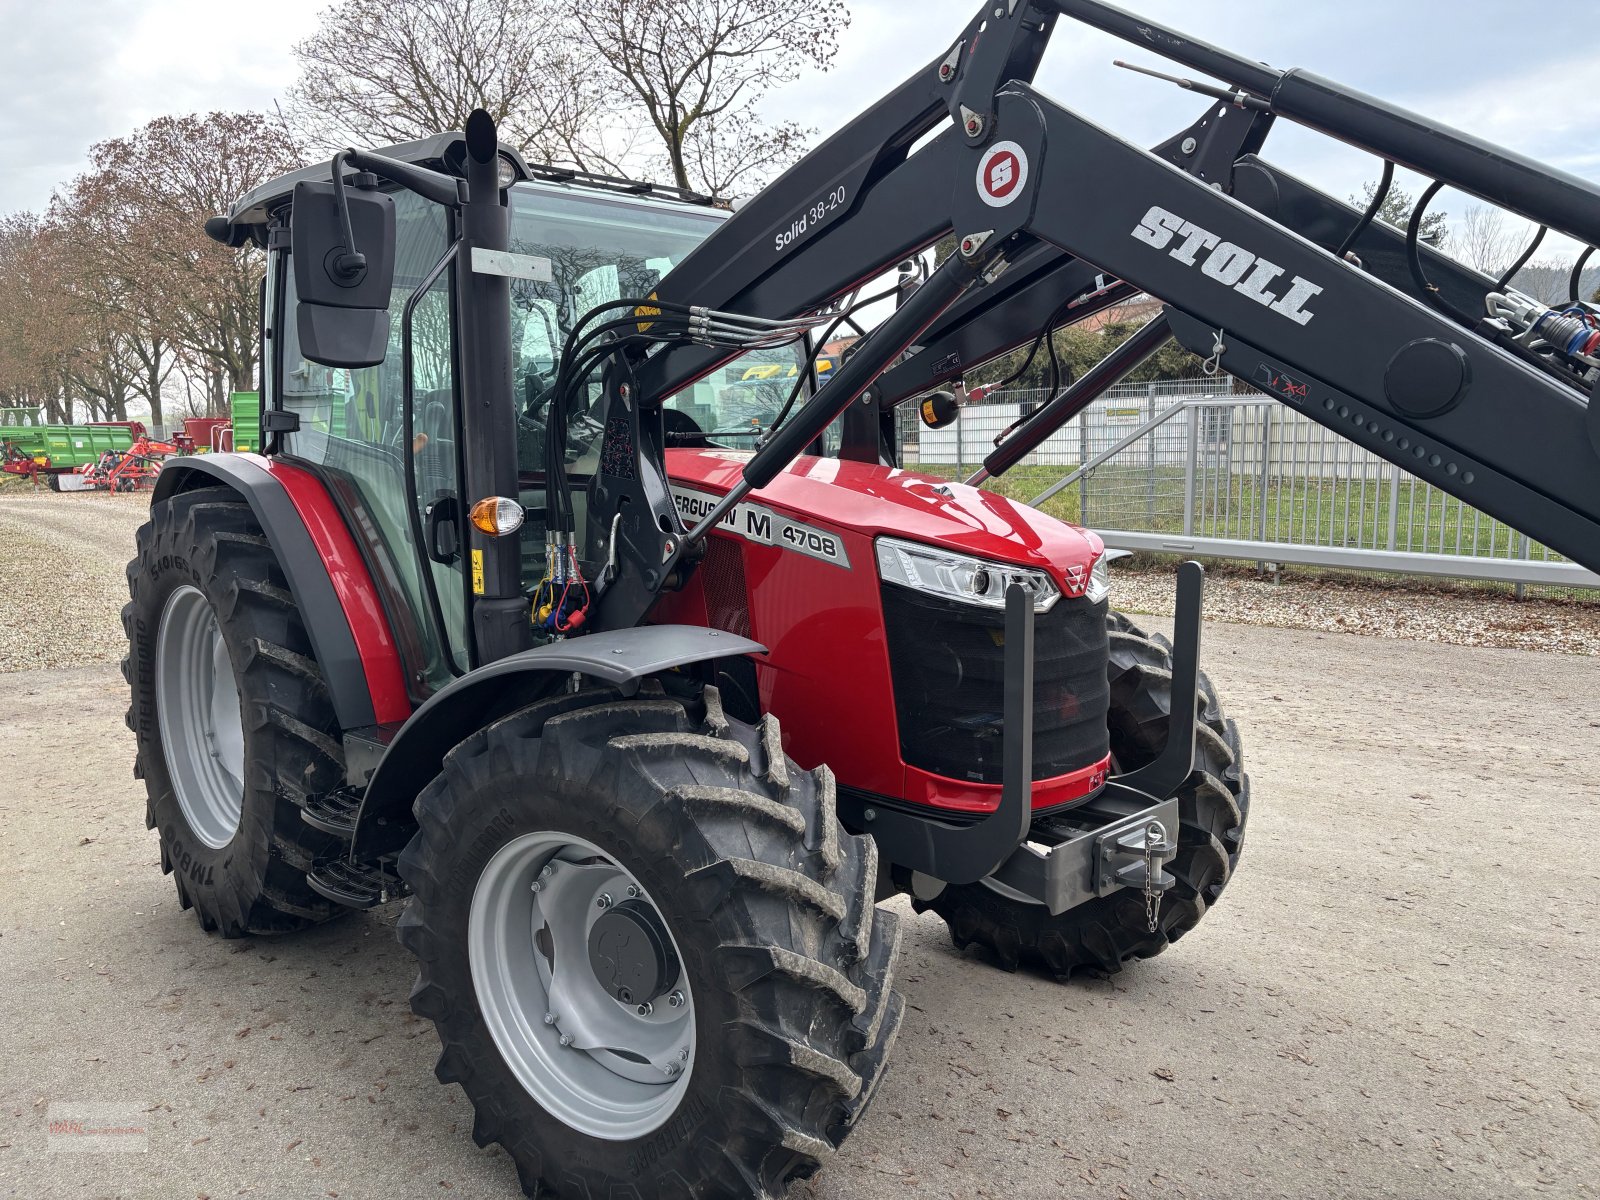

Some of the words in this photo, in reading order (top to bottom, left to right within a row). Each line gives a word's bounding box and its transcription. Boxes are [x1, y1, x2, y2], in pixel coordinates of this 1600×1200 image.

[775, 213, 807, 251] Solid
[809, 185, 846, 225] 38-20
[1130, 205, 1324, 327] STOLL
[746, 510, 772, 540] M
[782, 525, 837, 558] 4708
[163, 823, 215, 887] TM800
